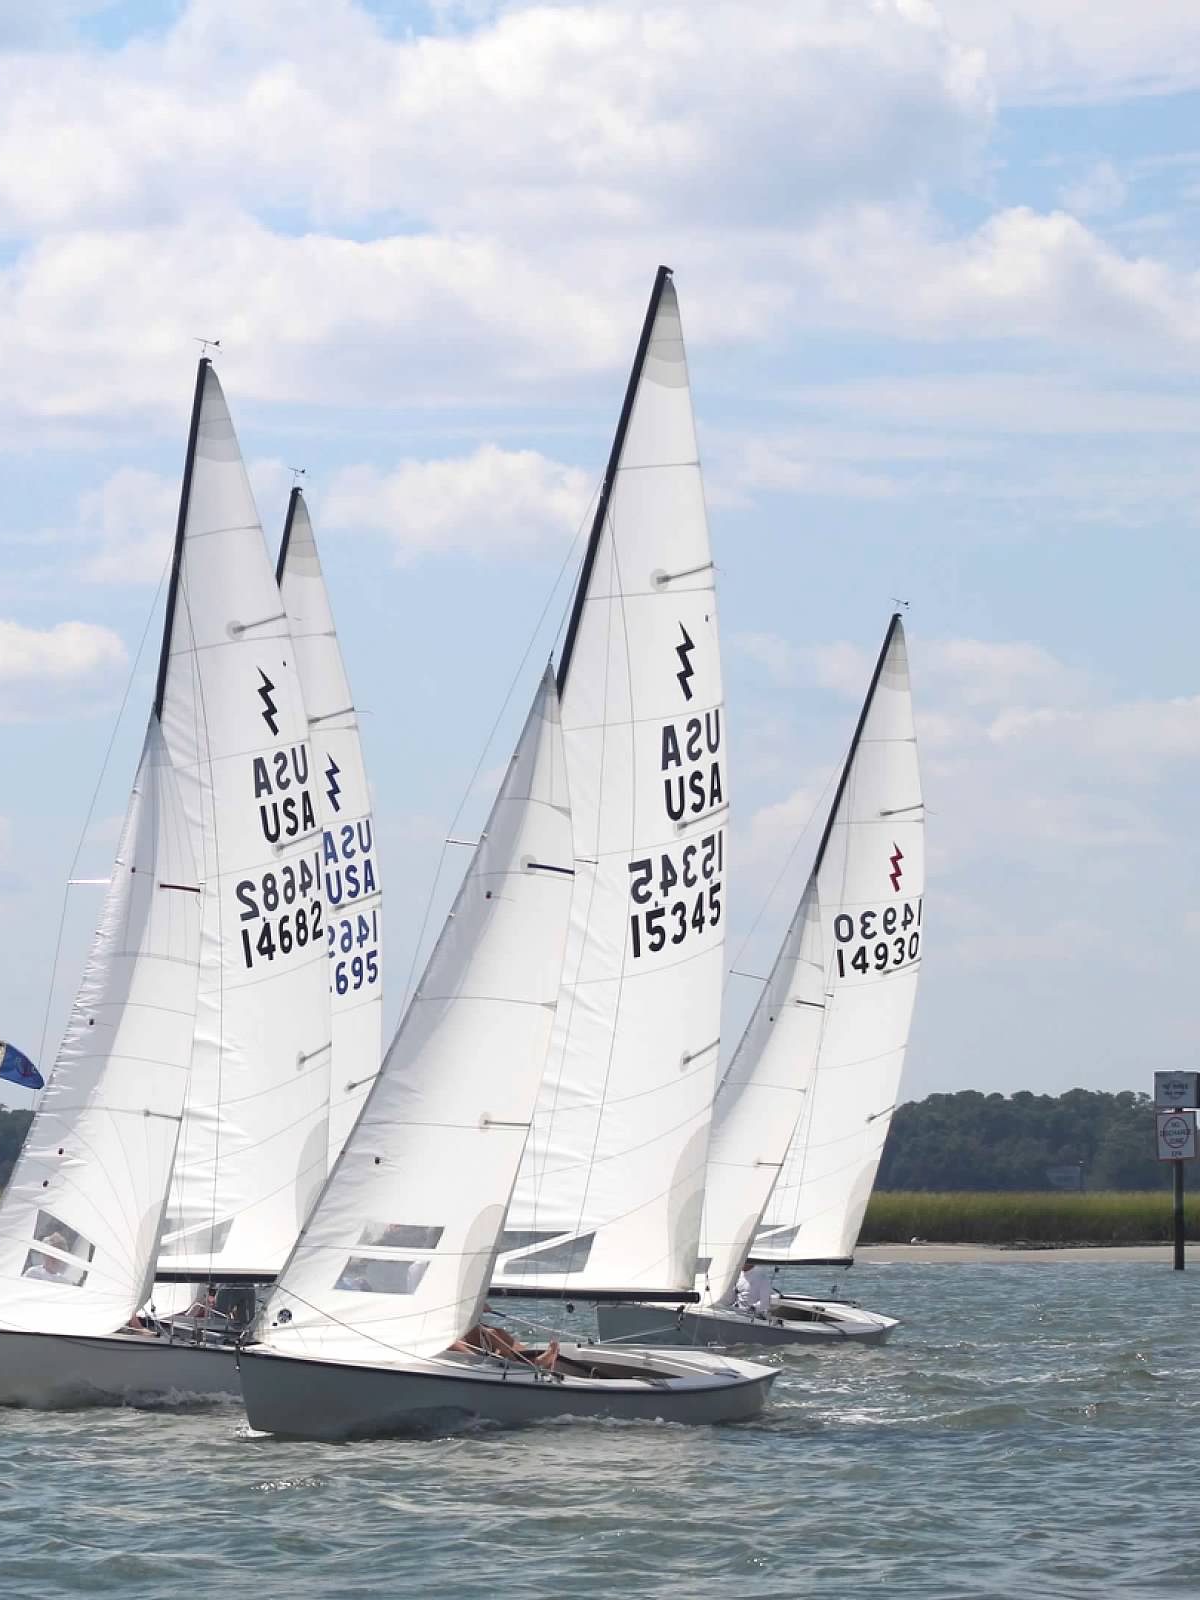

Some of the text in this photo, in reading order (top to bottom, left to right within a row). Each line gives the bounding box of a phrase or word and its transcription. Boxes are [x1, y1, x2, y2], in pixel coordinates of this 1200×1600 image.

[260, 791, 316, 843] USA
[664, 762, 722, 821] USA
[326, 859, 375, 904] USA
[241, 900, 324, 968] 14682
[630, 882, 721, 958] 15345
[330, 949, 378, 995] 695
[837, 932, 919, 978] 14930
